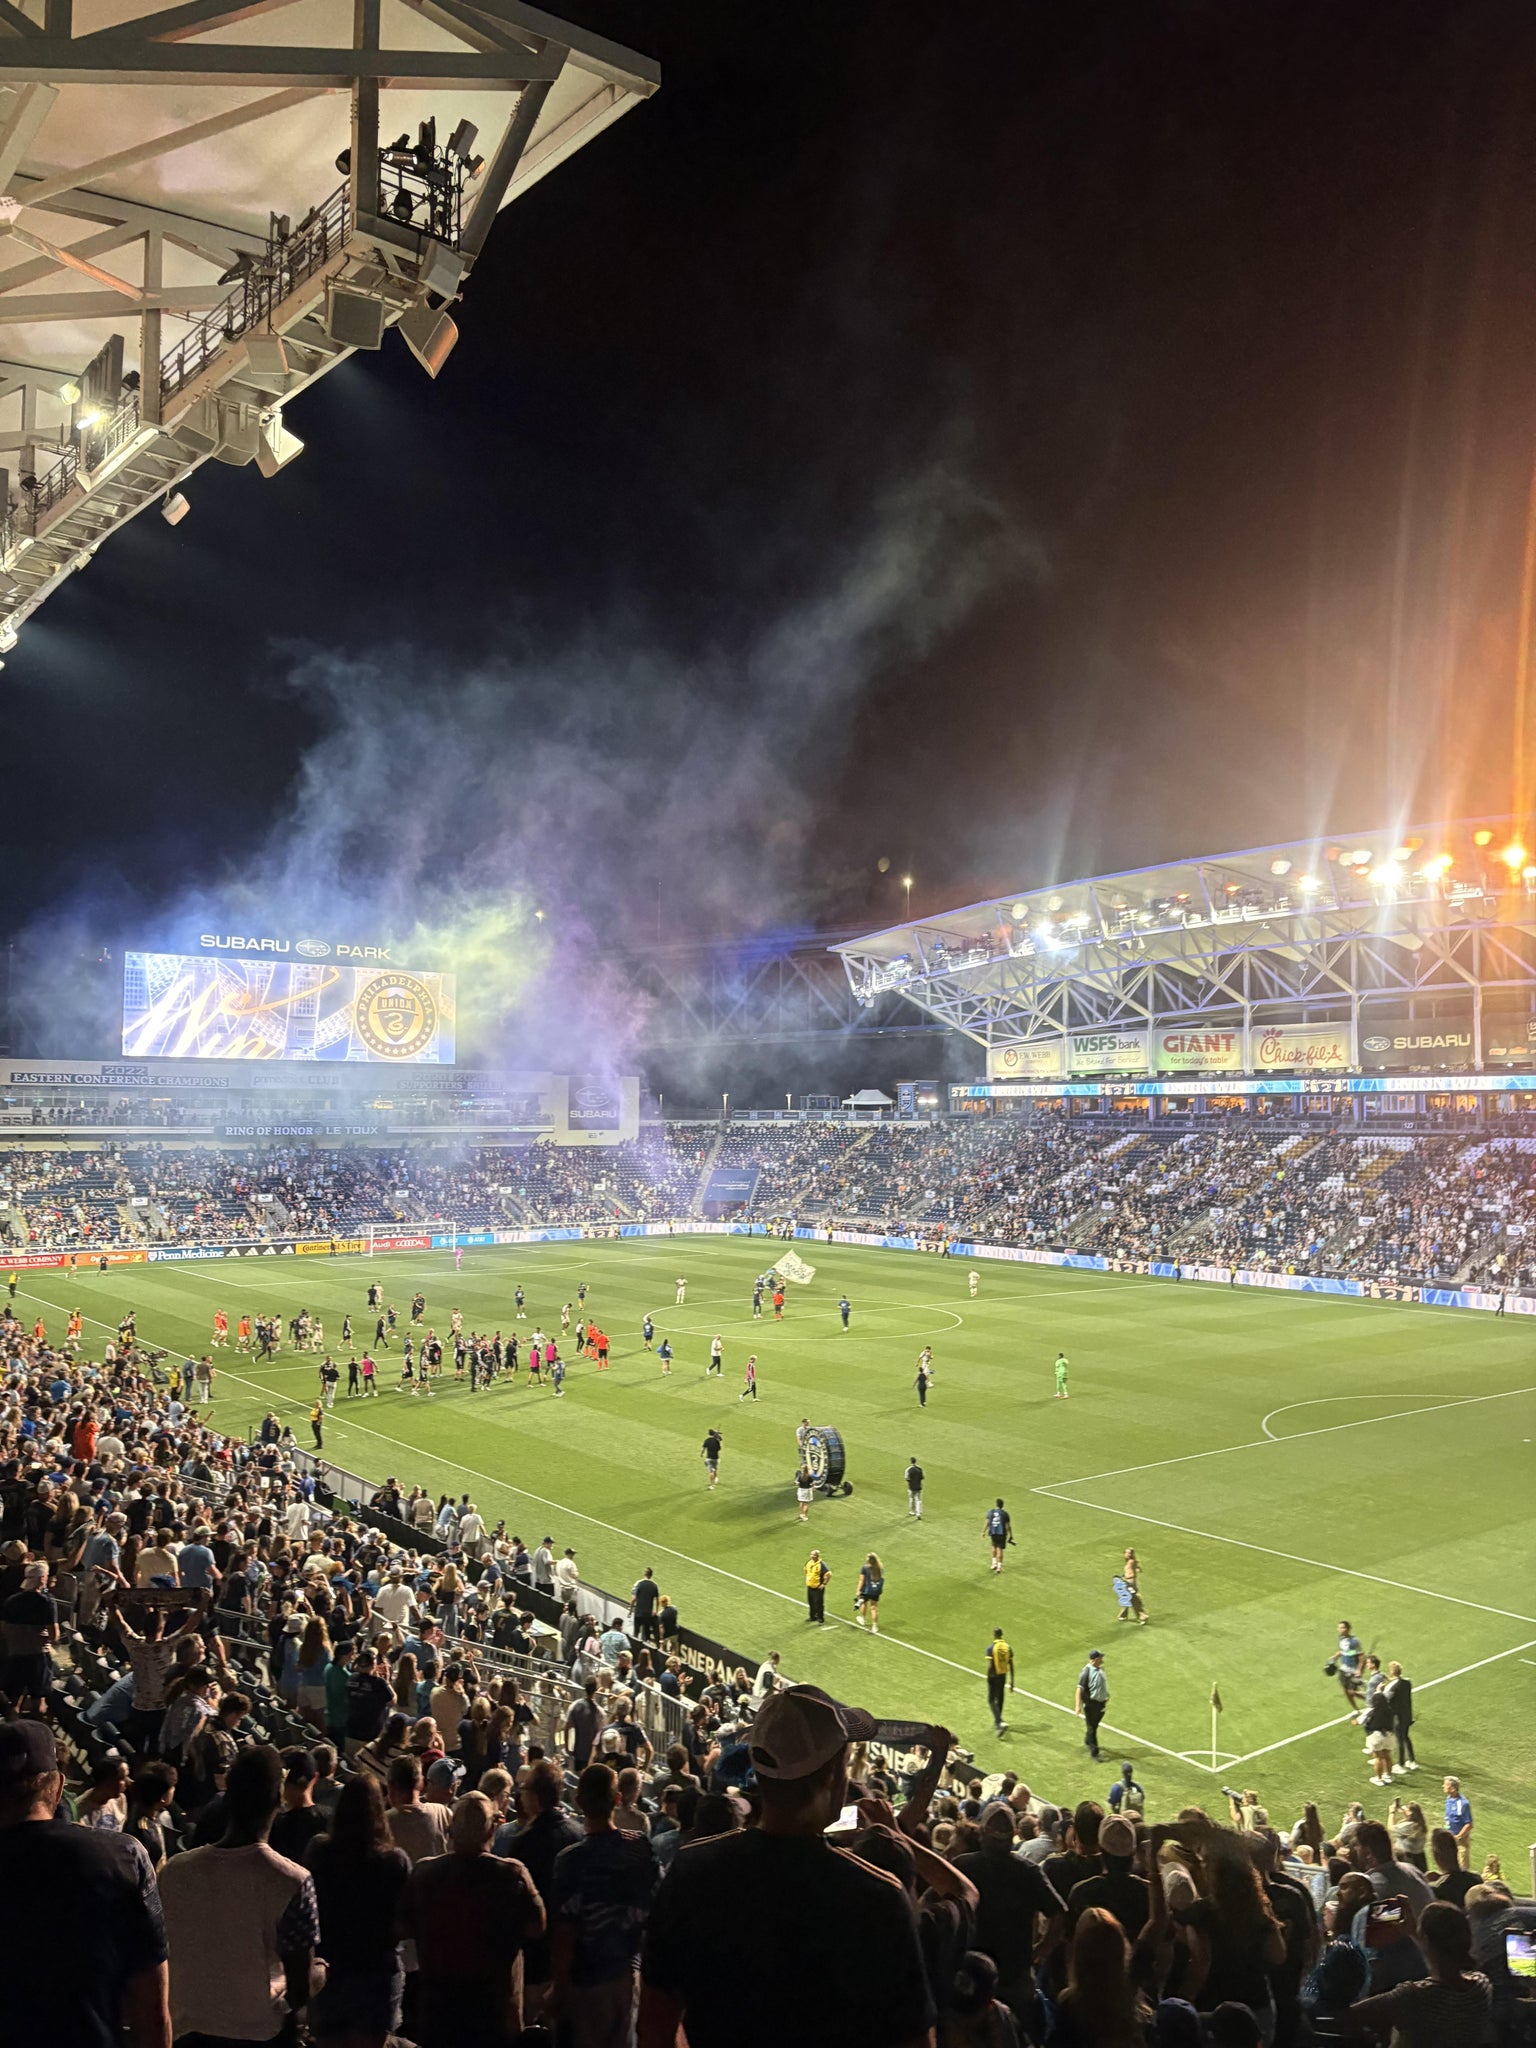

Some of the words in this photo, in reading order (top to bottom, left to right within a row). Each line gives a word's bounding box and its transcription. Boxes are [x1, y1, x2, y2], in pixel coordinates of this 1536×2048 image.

[200, 934, 290, 953] SUBARU
[336, 943, 392, 960] PARK
[358, 973, 434, 1015] PHILADELPHIA
[380, 996, 414, 1010] UNION
[1073, 1035, 1117, 1053] WSFS
[1118, 1037, 1140, 1050] bank
[1163, 1033, 1236, 1053] GIANT
[1393, 1033, 1472, 1050] SUBARU
[1259, 1034, 1344, 1065] Chick-fil-A
[1170, 1056, 1182, 1064] for
[1182, 1056, 1209, 1066] today's
[1209, 1056, 1229, 1064] table
[104, 1066, 147, 1076] 2022
[13, 1073, 72, 1084] EASTERN
[75, 1075, 155, 1086] CONFERENCE
[158, 1077, 228, 1088] CHAMPIONS
[569, 1110, 616, 1119] SUBARU
[224, 1126, 254, 1136] RING
[256, 1126, 272, 1136] OF
[273, 1126, 313, 1136] HONOR
[326, 1126, 341, 1135] LE
[345, 1126, 378, 1135] TOUX
[29, 1255, 63, 1264] COMPANY
[157, 1250, 182, 1260] Penn
[182, 1248, 225, 1259] Medicine
